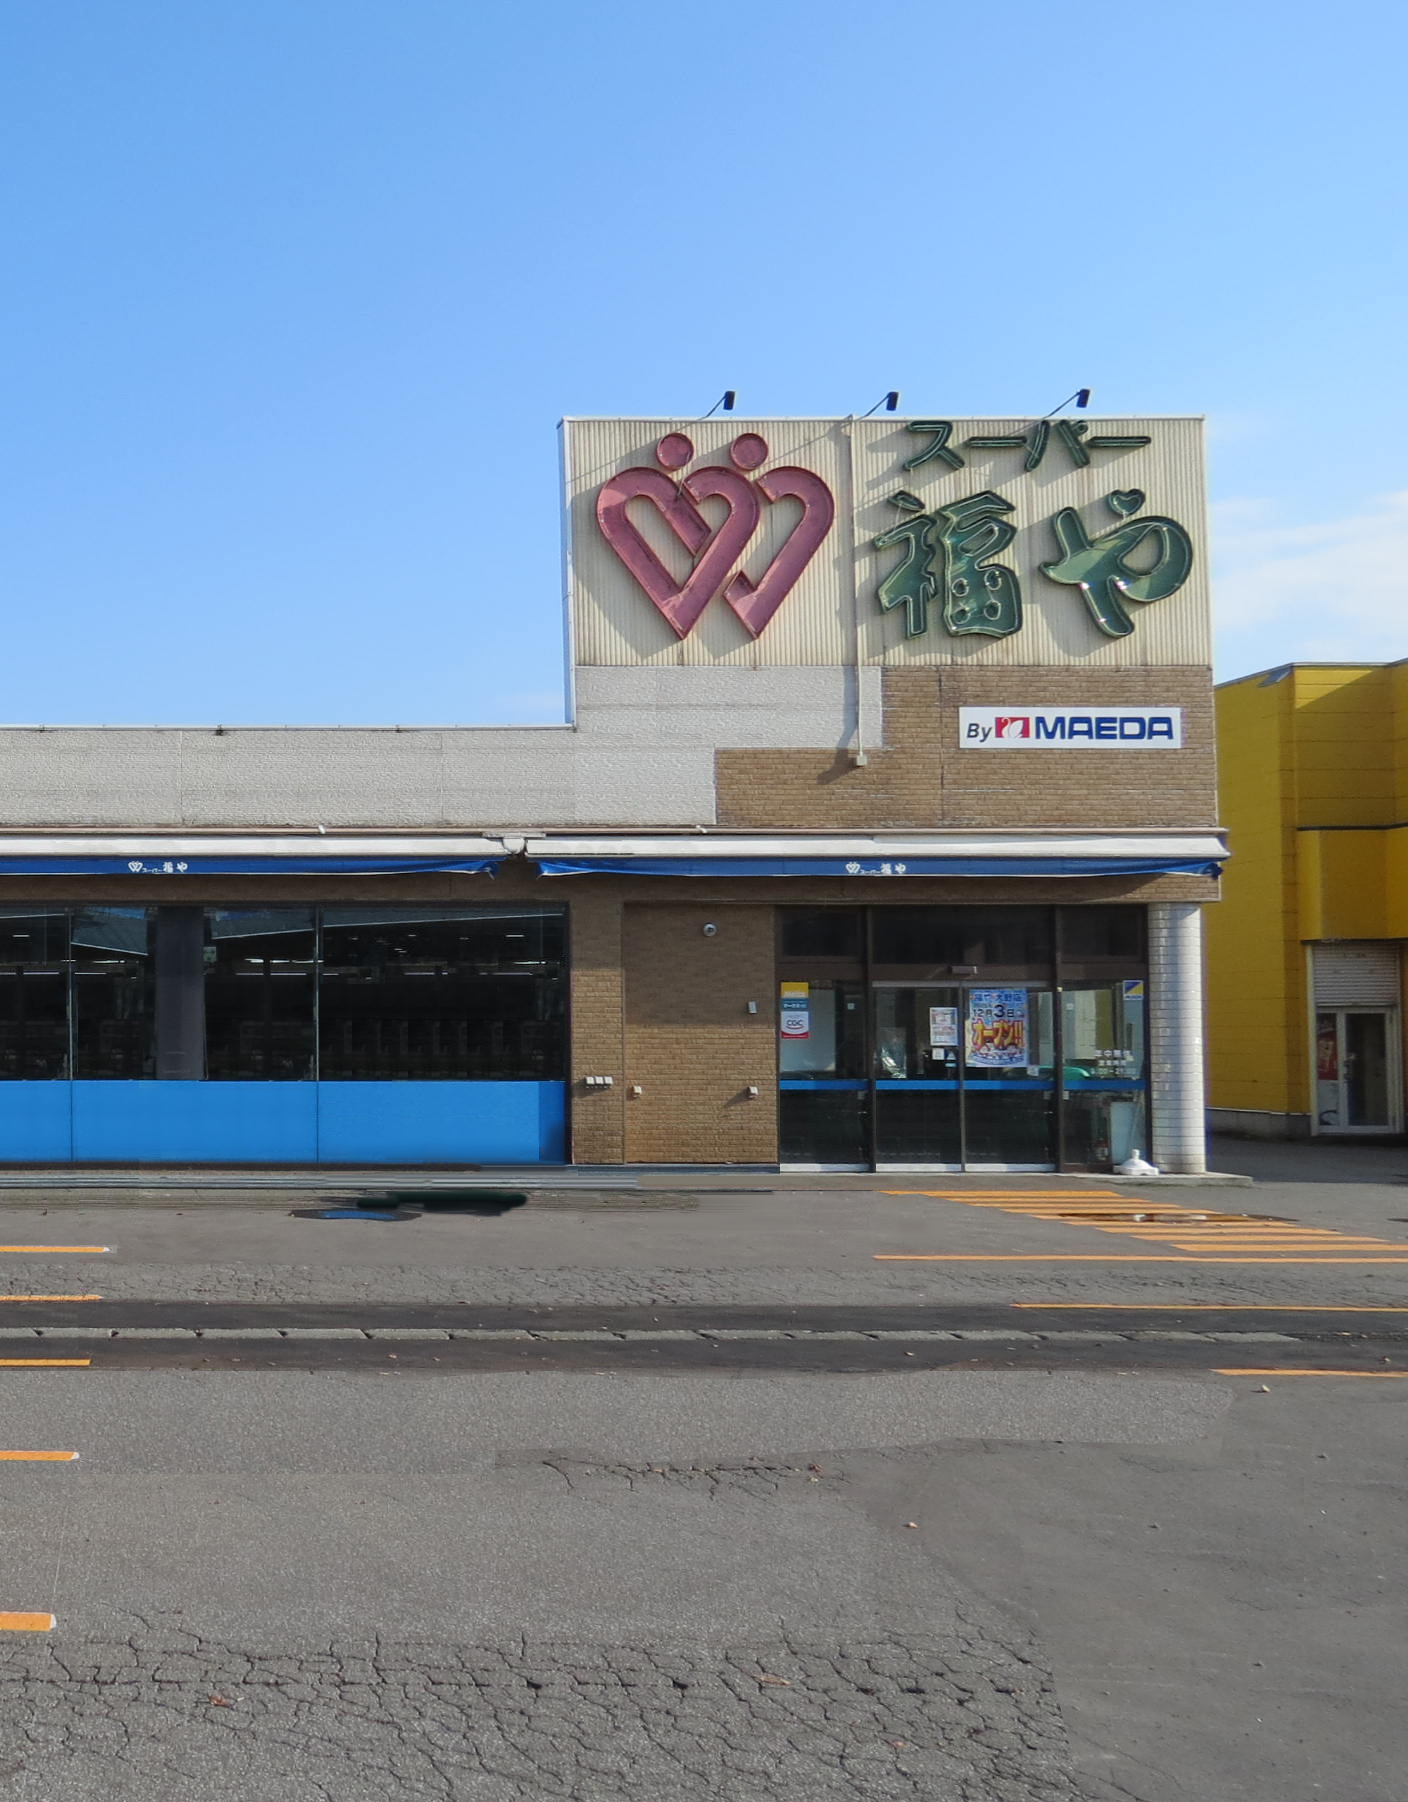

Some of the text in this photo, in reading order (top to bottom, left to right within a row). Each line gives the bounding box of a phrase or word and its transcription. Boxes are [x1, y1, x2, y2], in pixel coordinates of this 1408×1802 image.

[903, 419, 1152, 472] スーパー
[873, 489, 1193, 640] 福や
[966, 716, 1174, 742] By MAEDA
